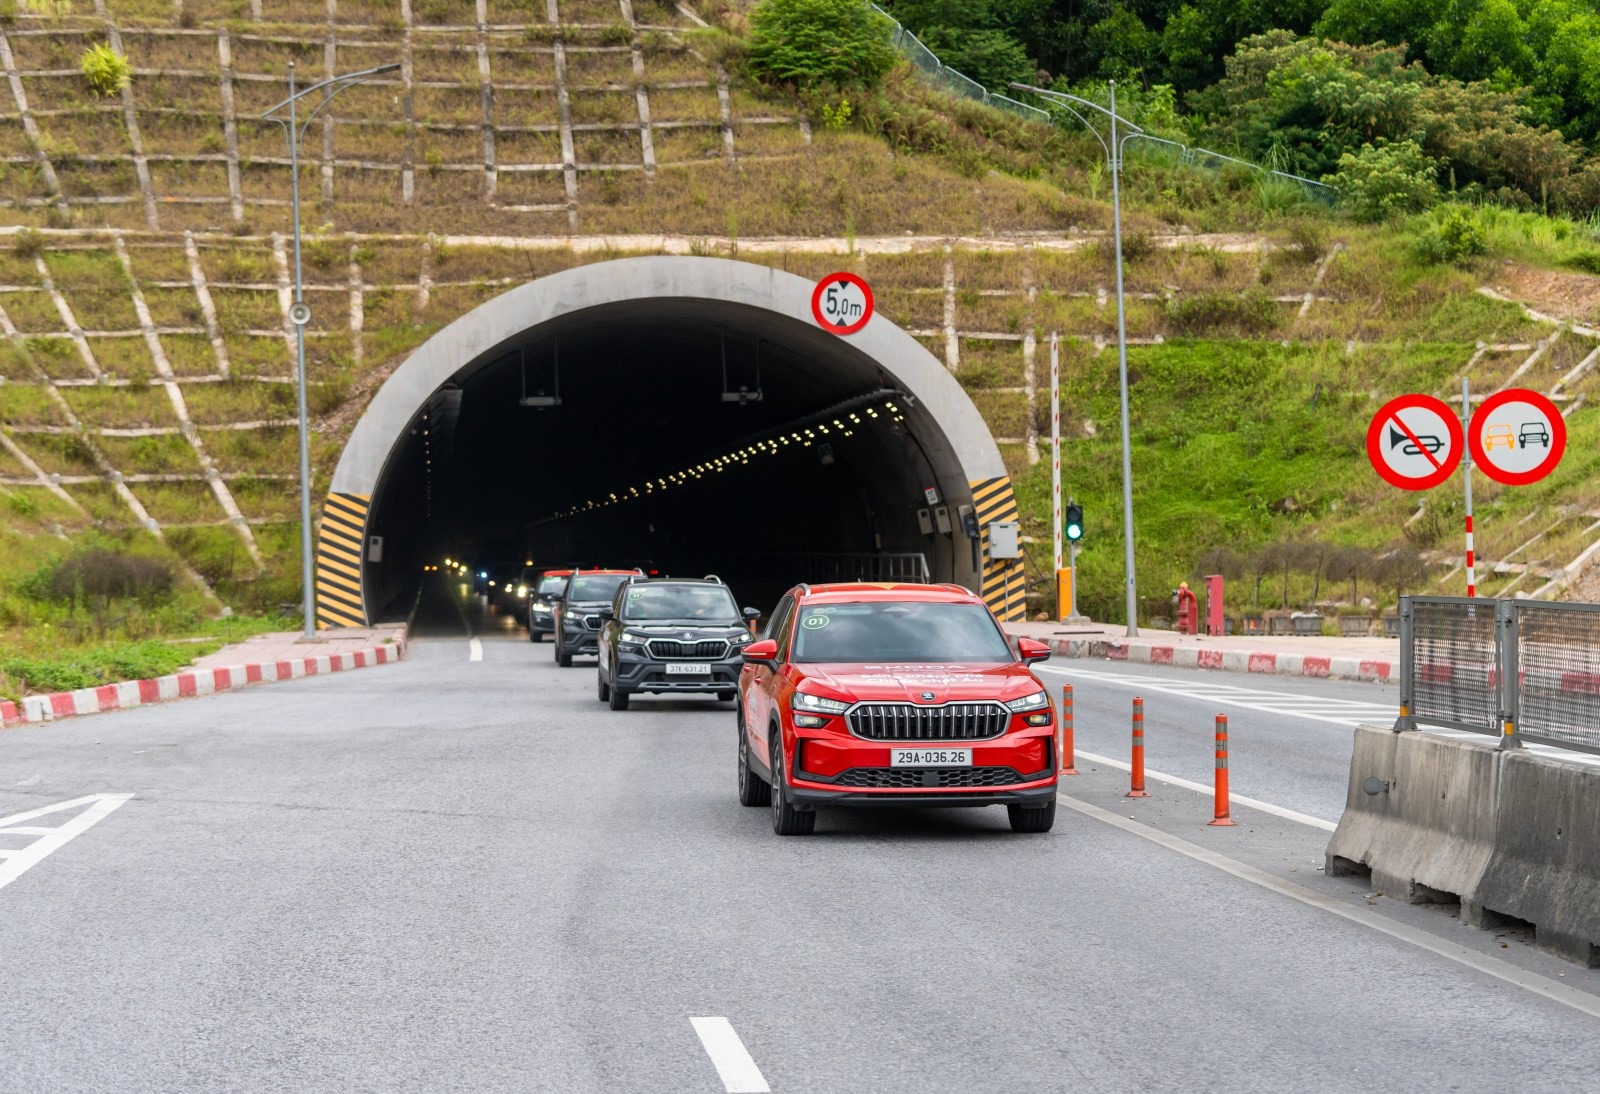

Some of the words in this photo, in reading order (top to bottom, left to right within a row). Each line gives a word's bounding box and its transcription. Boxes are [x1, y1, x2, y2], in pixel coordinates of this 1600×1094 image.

[808, 617, 824, 626] 01
[669, 665, 708, 673] 37K-631.21
[898, 751, 966, 763] 29A-036.26
